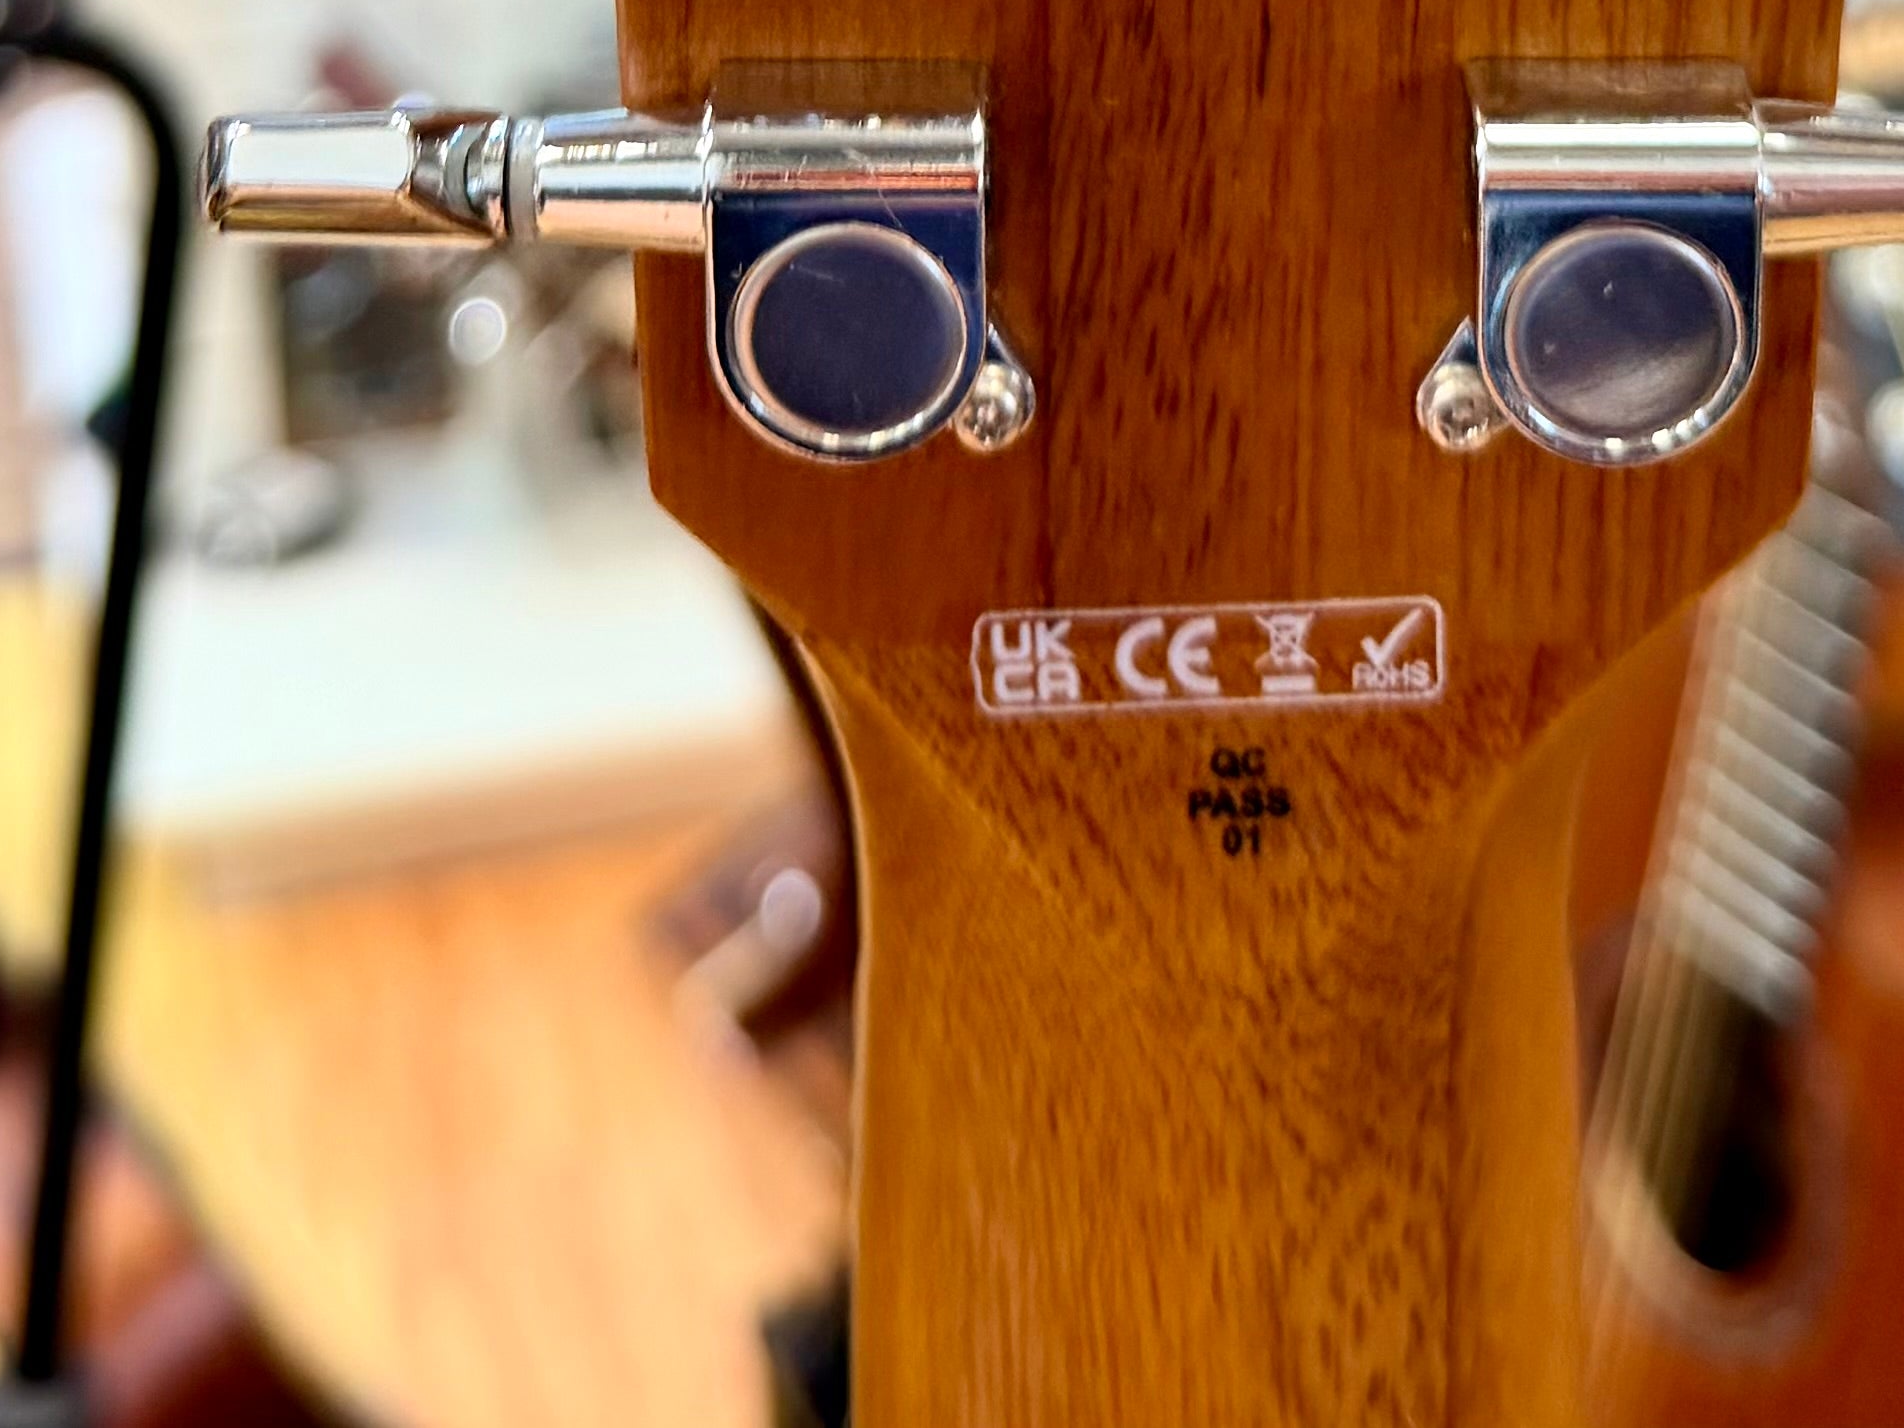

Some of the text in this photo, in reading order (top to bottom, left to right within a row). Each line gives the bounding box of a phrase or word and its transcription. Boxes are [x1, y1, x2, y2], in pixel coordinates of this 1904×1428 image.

[1114, 616, 1221, 697] CE
[1209, 747, 1266, 778] QC
[1188, 787, 1292, 819] PASS
[1221, 824, 1262, 857] 01
